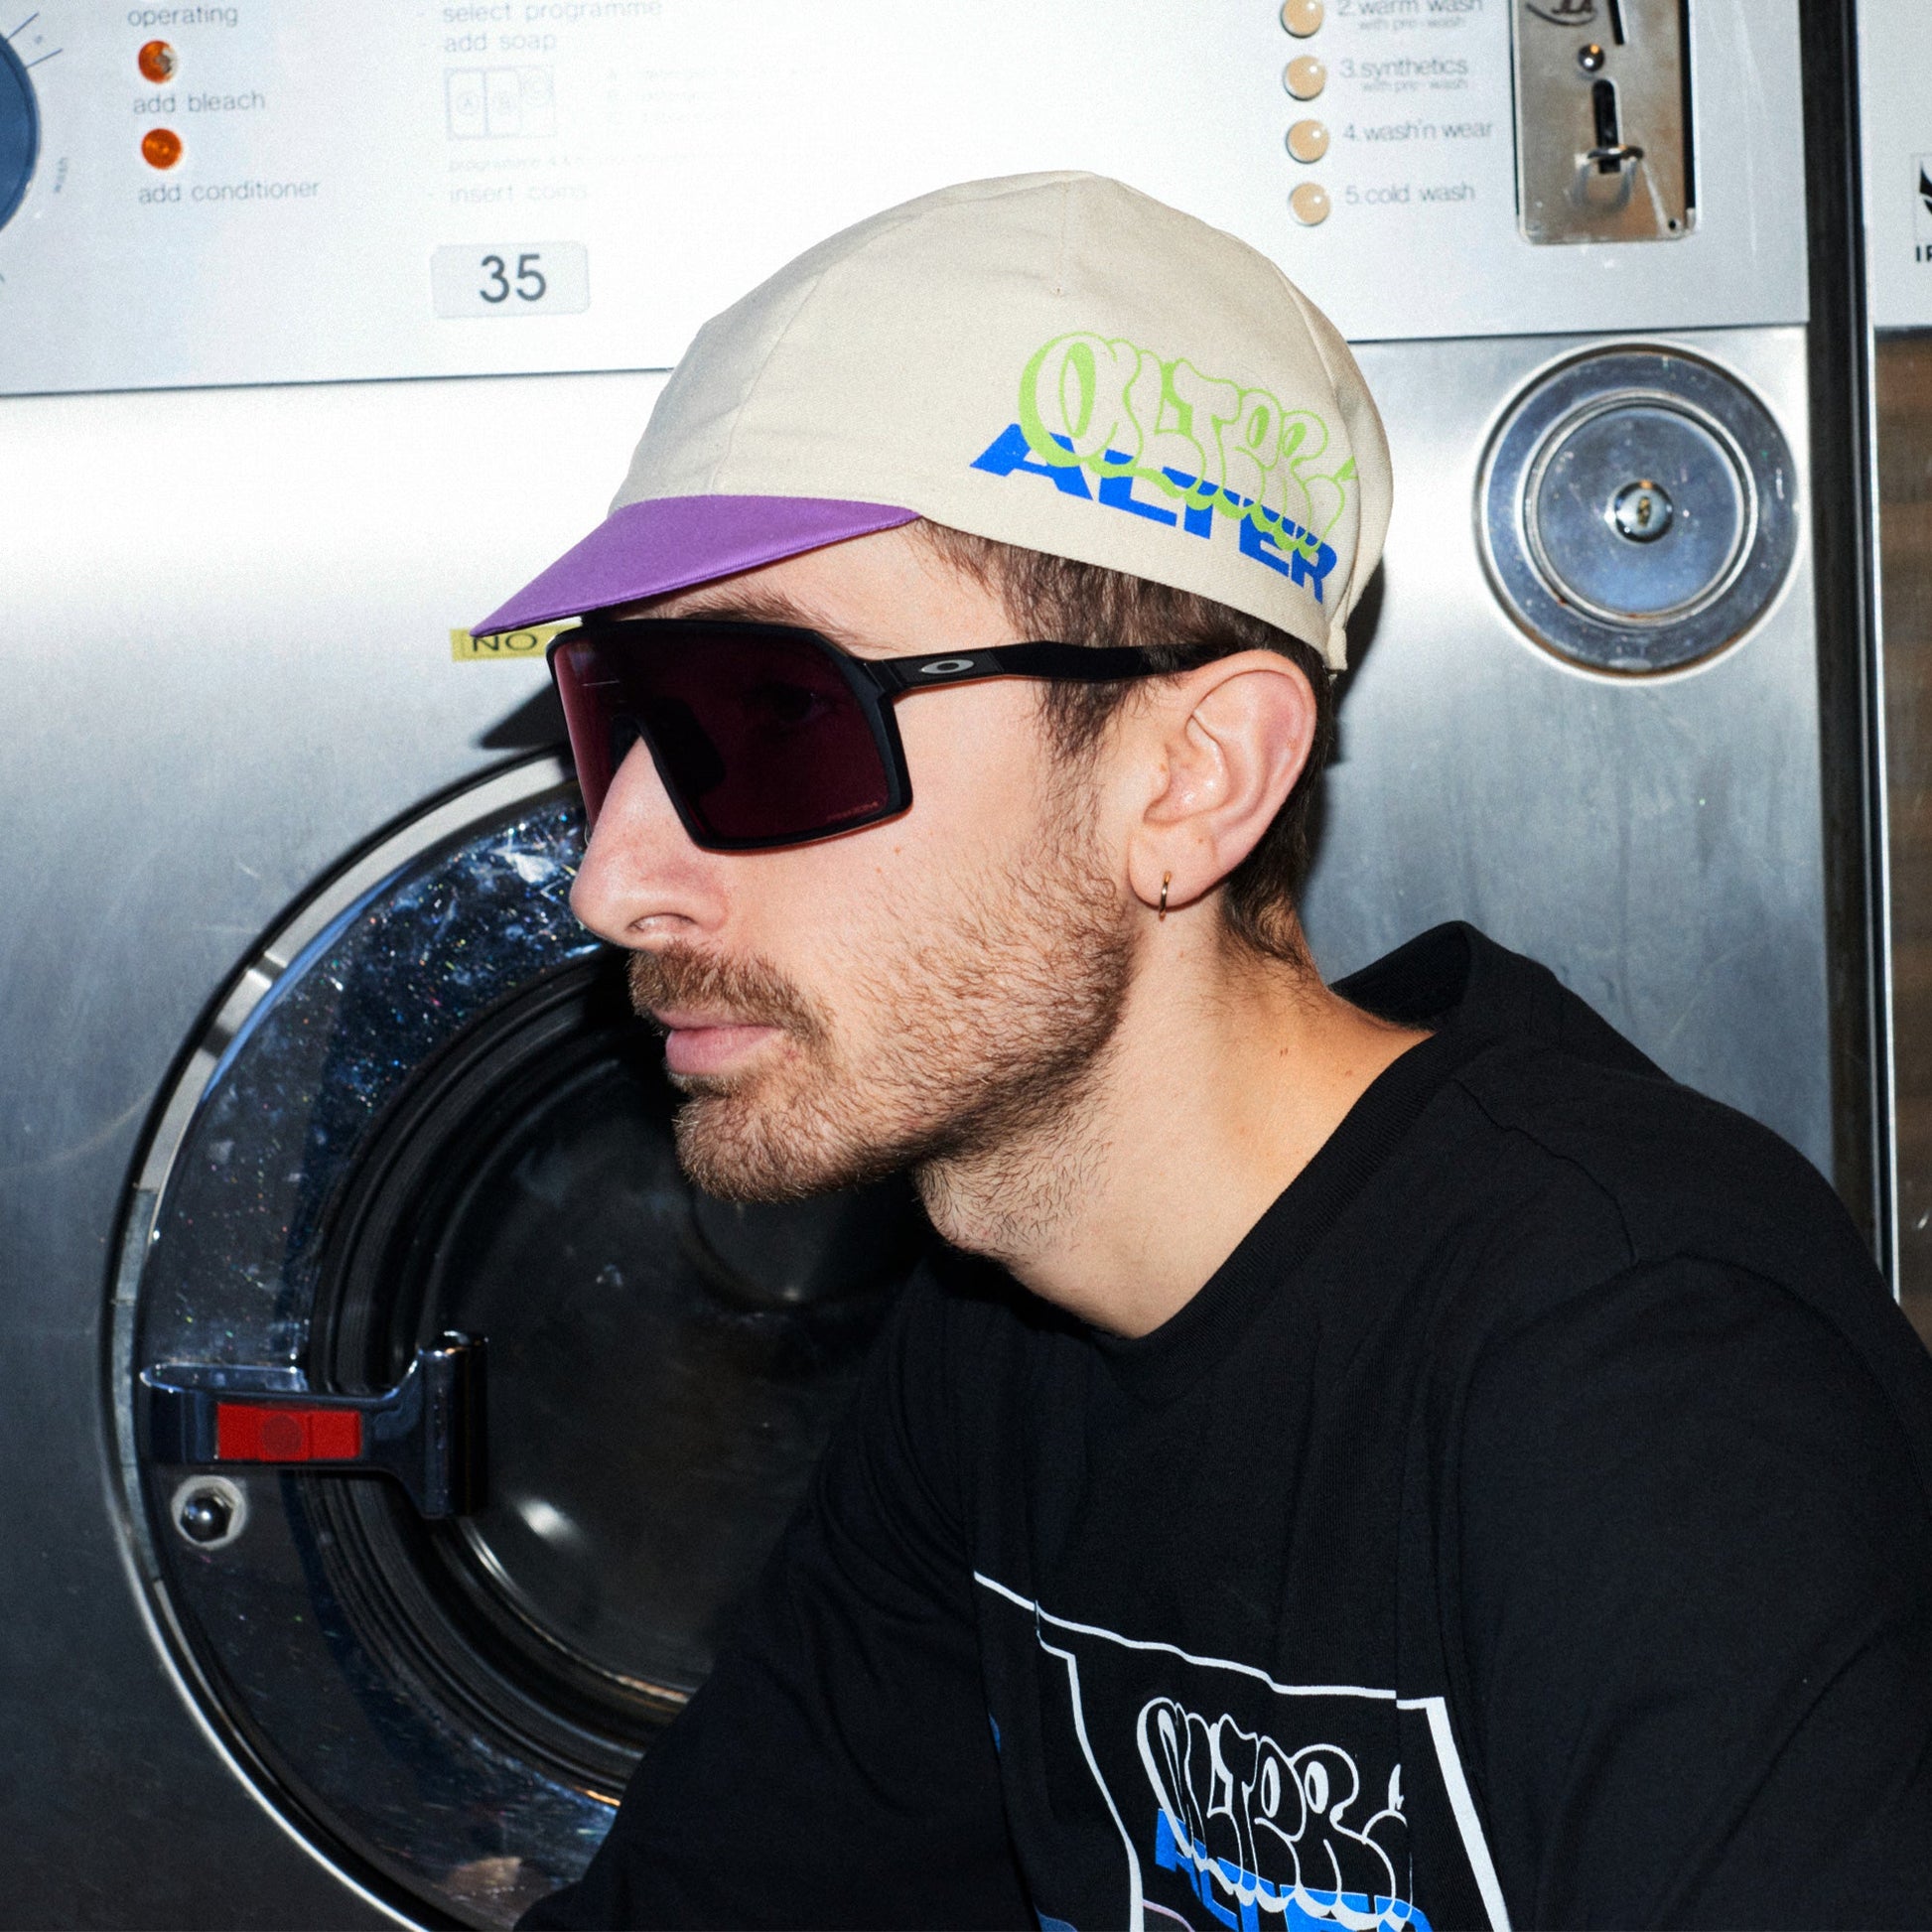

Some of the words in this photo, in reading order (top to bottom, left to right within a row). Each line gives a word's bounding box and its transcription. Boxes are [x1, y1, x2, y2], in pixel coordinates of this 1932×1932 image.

[127, 7, 238, 28] operating
[443, 2, 512, 23] select
[525, 0, 663, 23] programme
[443, 33, 487, 53] add
[499, 33, 557, 53] soap
[133, 94, 176, 115] add
[188, 90, 266, 113] bleach
[1443, 121, 1493, 139] wear
[138, 185, 181, 205] add
[192, 179, 323, 203] conditioner
[449, 184, 513, 205] insert
[1420, 180, 1476, 202] wash
[480, 253, 547, 303] 35
[969, 423, 1338, 604] ALTER
[472, 631, 539, 652] NO
